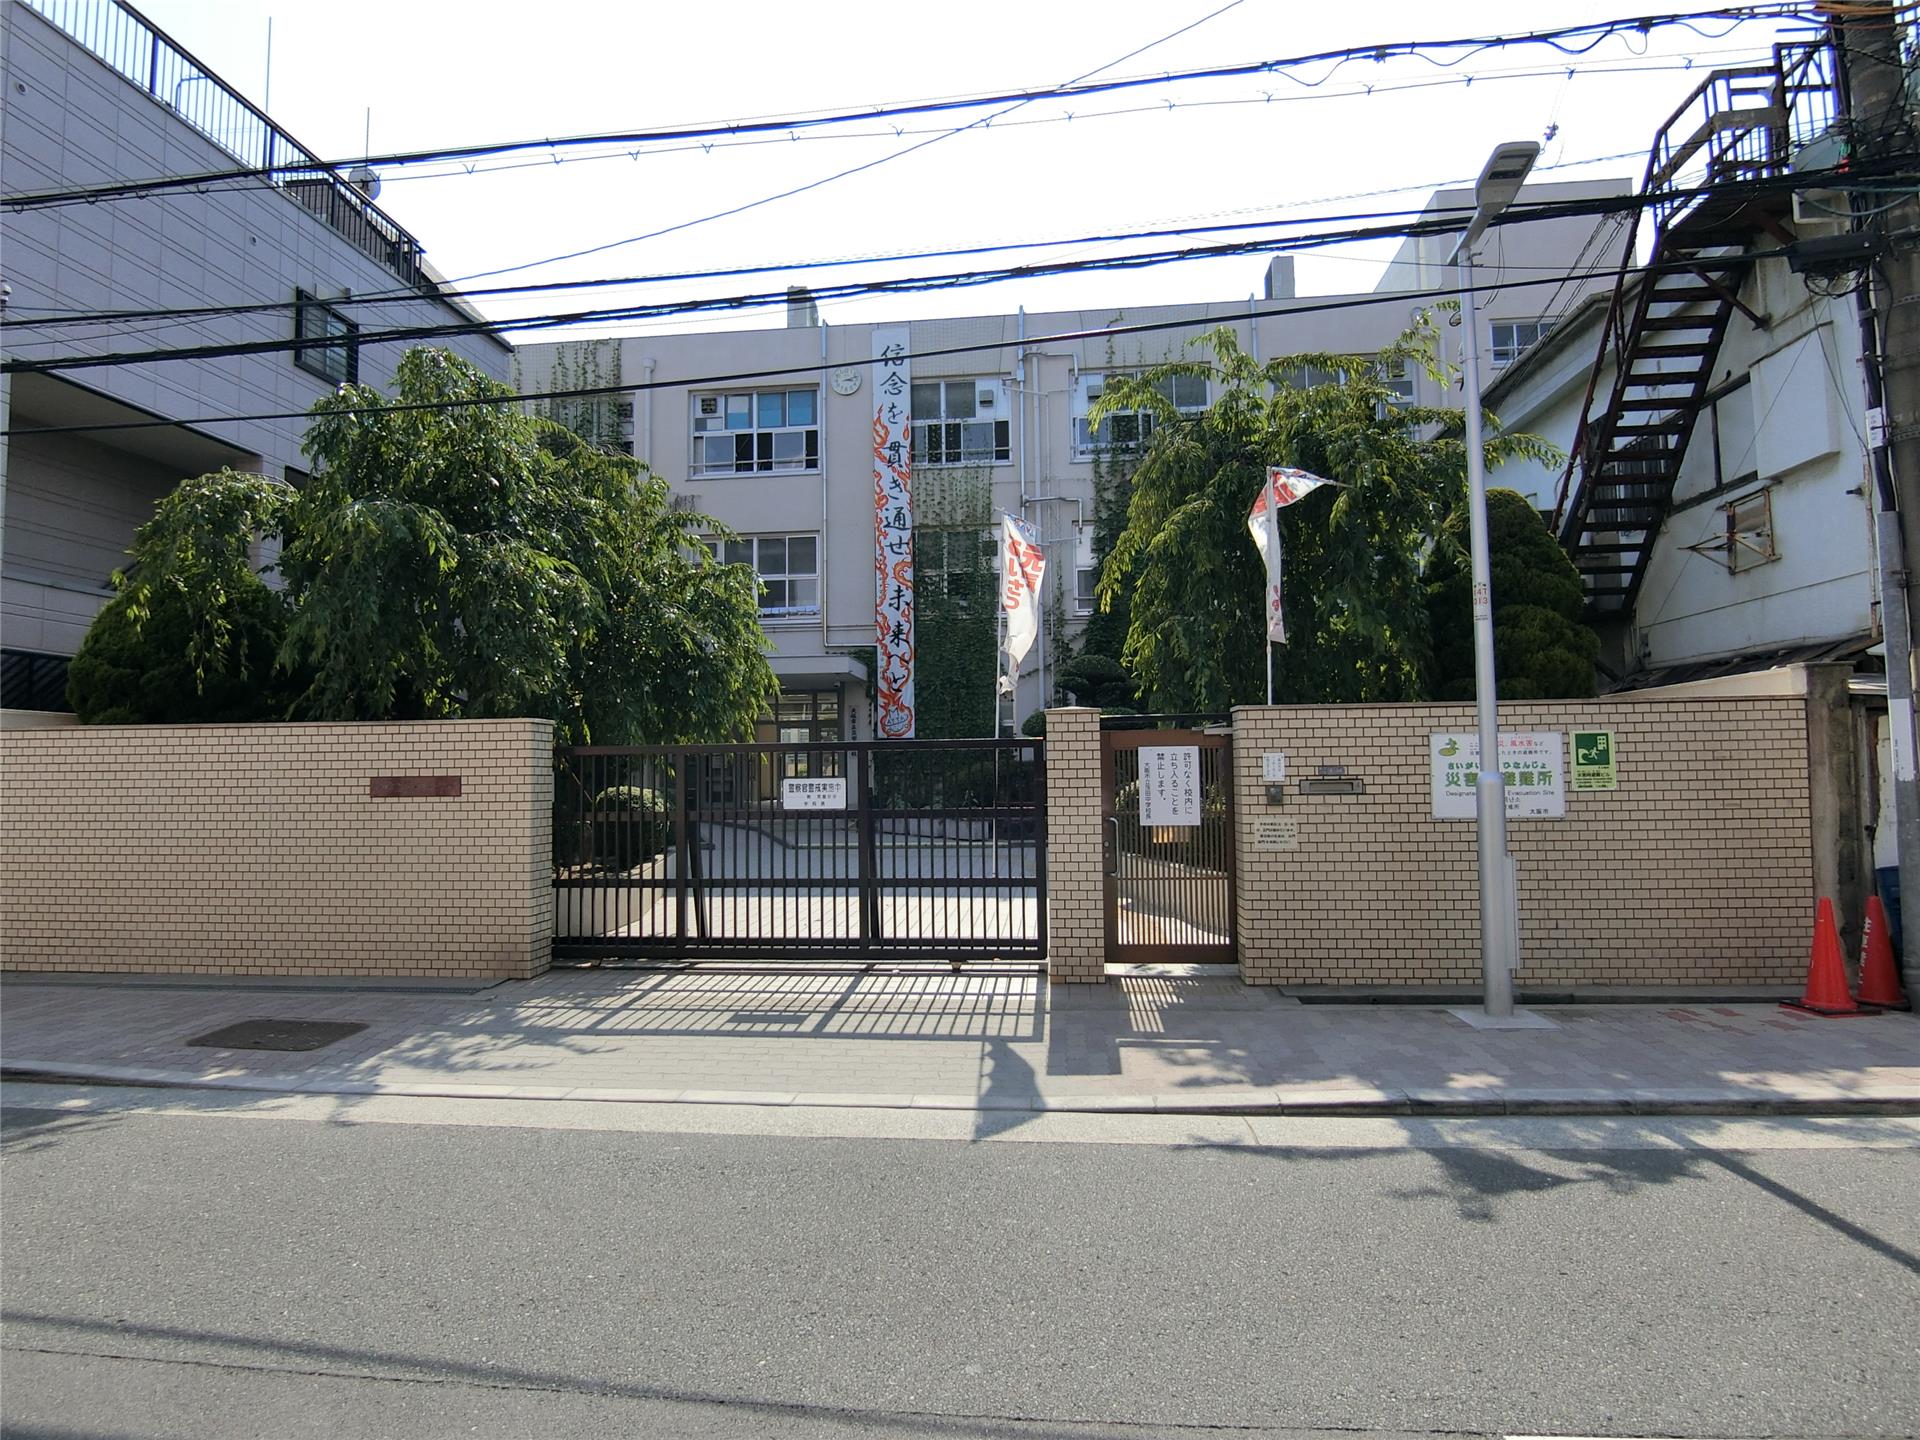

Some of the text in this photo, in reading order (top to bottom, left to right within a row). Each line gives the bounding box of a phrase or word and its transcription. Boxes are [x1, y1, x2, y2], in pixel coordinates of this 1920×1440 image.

[1157, 752, 1166, 801] 禁止します。
[1170, 752, 1179, 816] 立ち入ることを
[1183, 752, 1193, 815] 許可なく校内に
